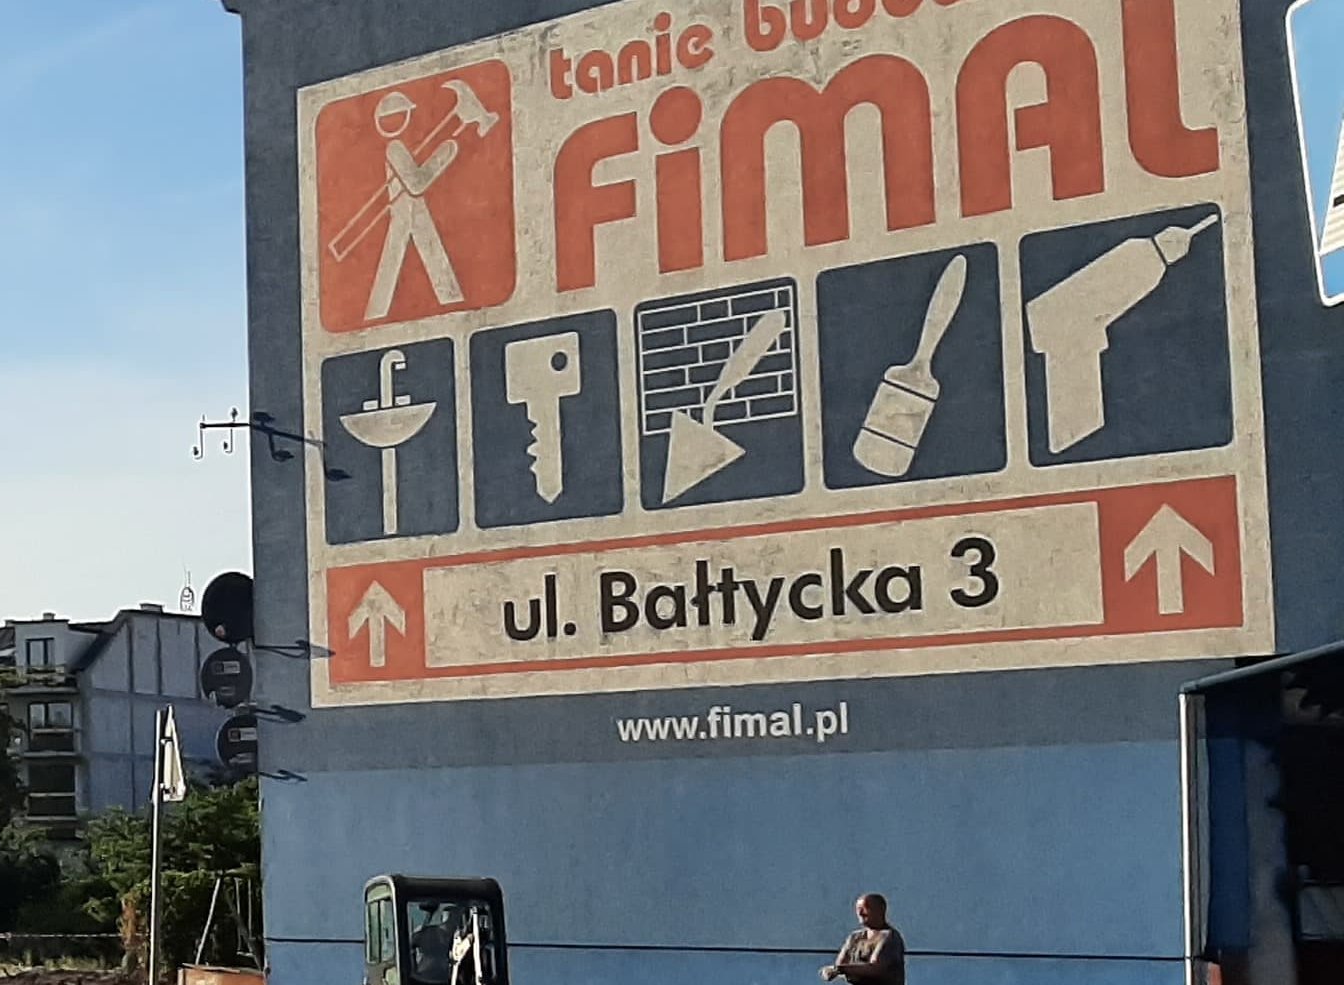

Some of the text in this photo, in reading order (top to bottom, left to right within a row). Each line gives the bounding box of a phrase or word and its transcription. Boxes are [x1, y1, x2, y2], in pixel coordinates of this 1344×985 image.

[549, 11, 714, 100] tanie
[503, 536, 999, 642] ul. Bałtycka 3
[616, 702, 849, 743] www.fimal.pl
